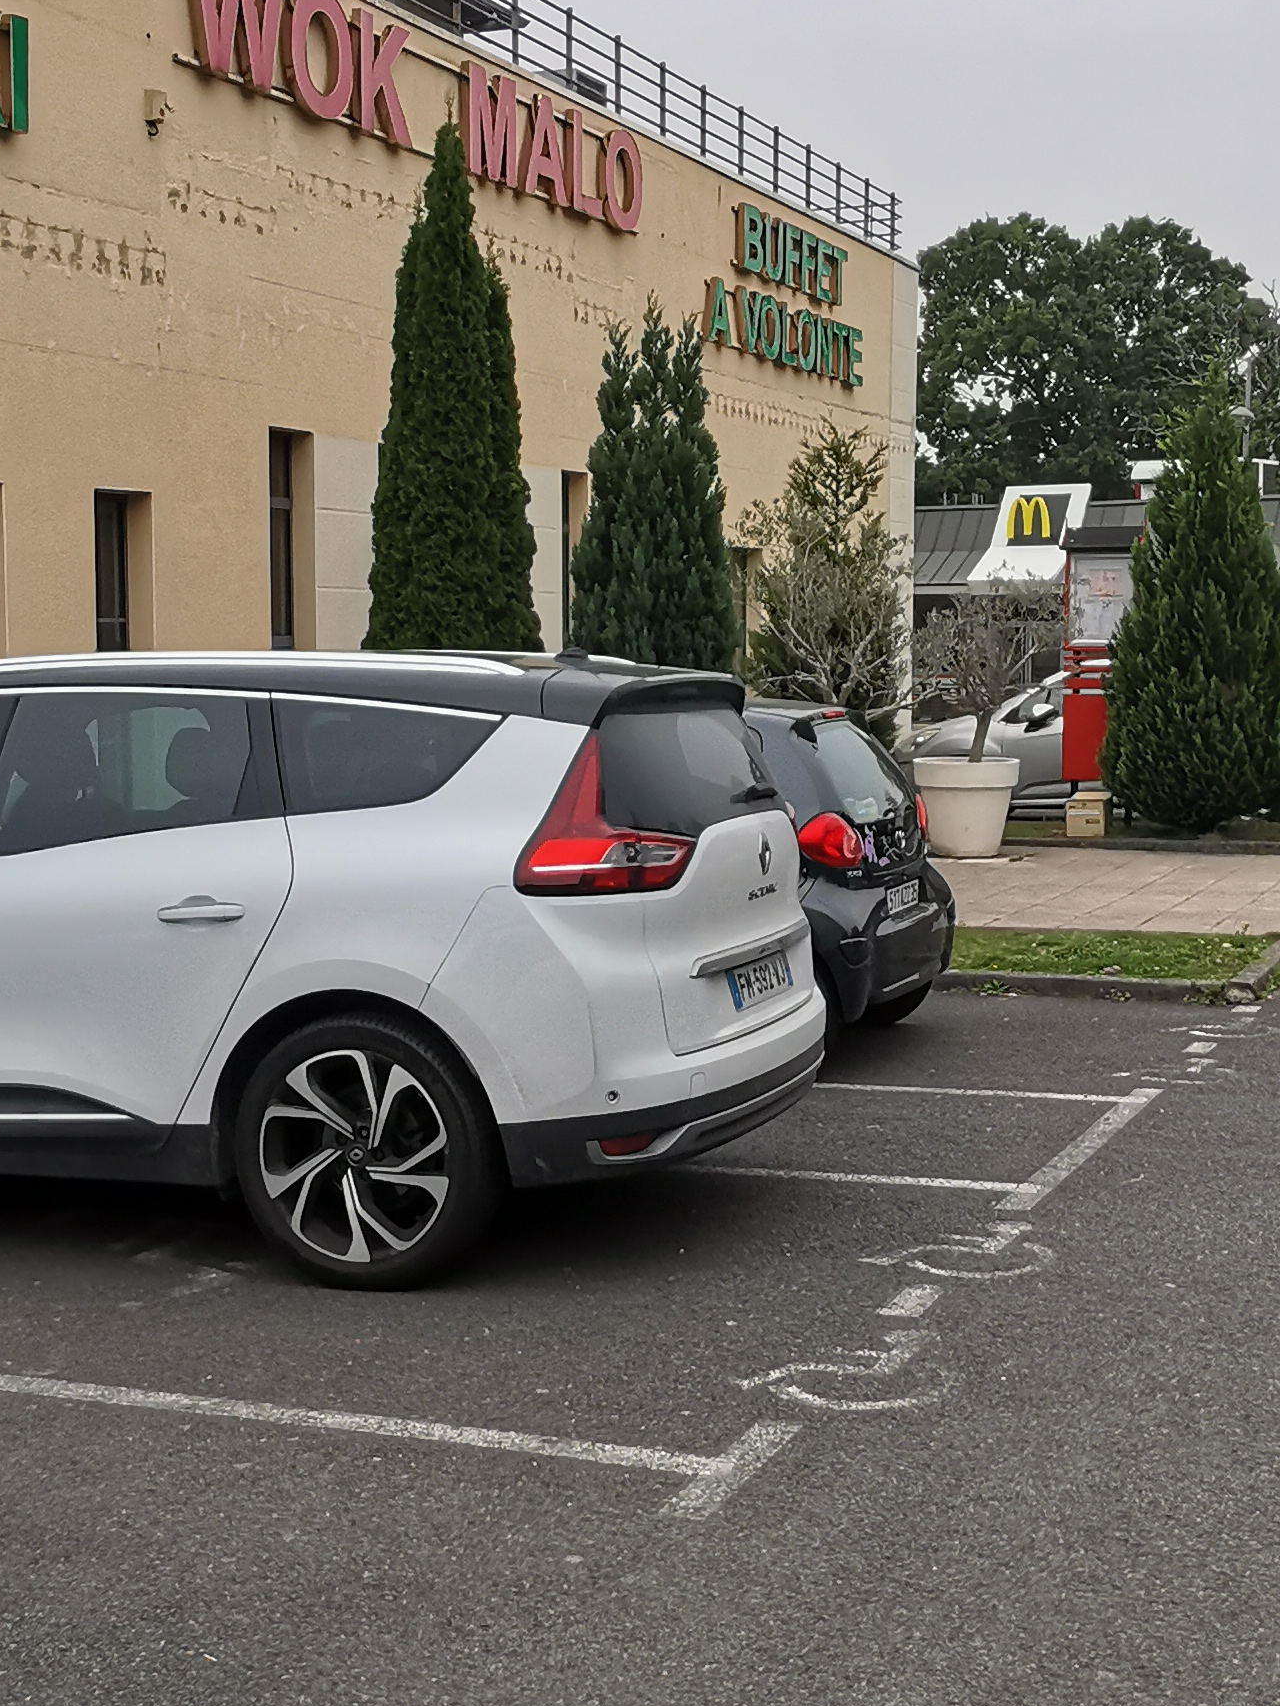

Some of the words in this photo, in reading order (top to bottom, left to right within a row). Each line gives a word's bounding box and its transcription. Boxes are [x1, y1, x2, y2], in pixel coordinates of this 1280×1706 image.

[461, 60, 643, 232] MALO
[736, 202, 849, 306] BUFFET
[702, 276, 732, 347] A
[735, 285, 864, 387] VOLONTE
